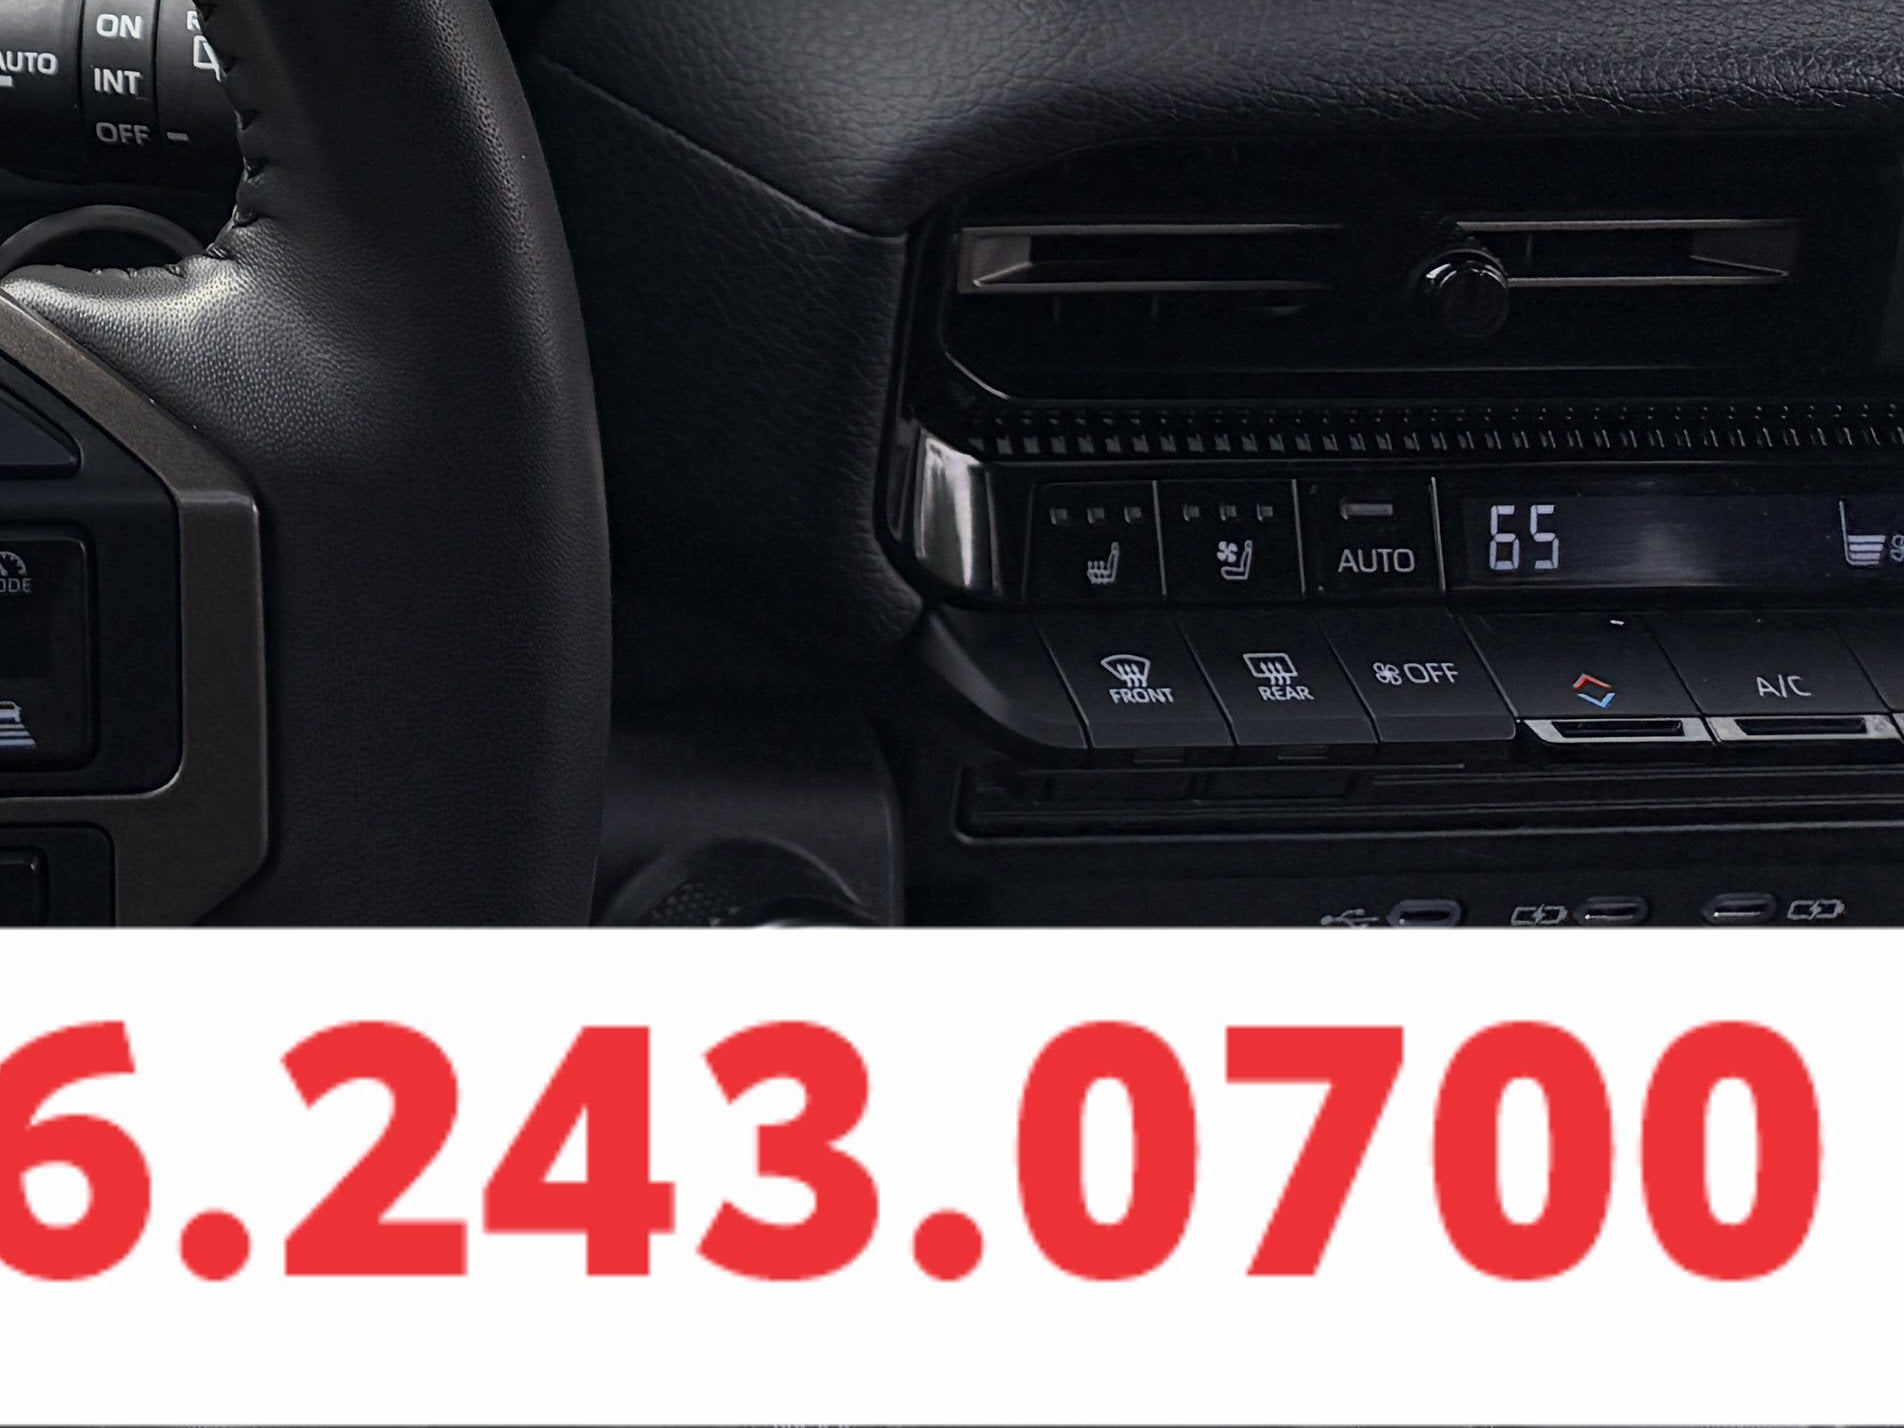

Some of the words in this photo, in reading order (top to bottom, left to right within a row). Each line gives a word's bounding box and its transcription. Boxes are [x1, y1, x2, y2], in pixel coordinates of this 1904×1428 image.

[97, 13, 143, 38] ON
[94, 68, 140, 94] INT
[96, 122, 148, 144] OFF
[1490, 505, 1559, 570] 65
[1338, 549, 1415, 572] AUTO
[1404, 663, 1458, 683] OFF
[1109, 688, 1174, 704] FRONT
[1258, 686, 1313, 701] REAR
[1757, 675, 1811, 697] A/C
